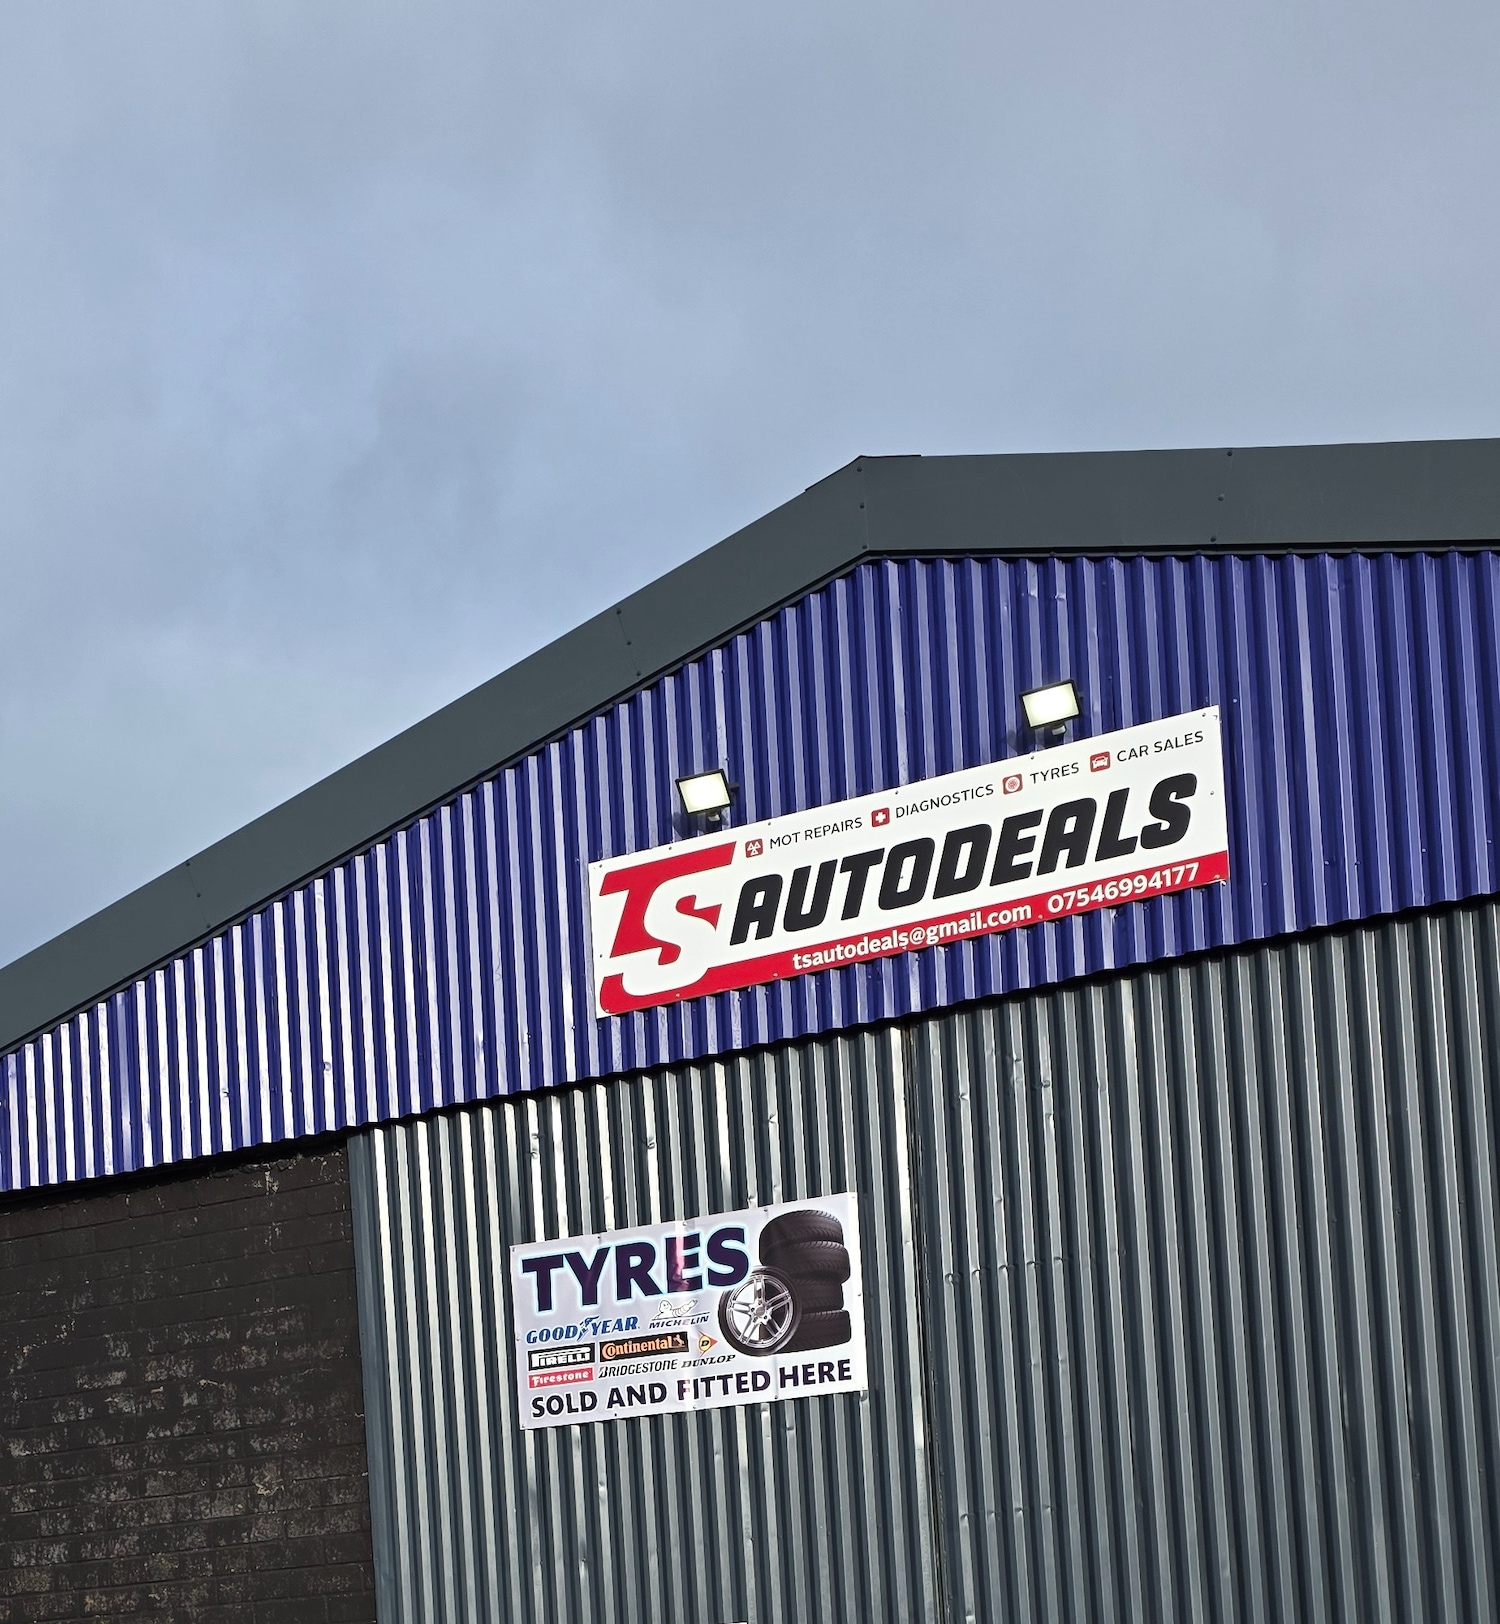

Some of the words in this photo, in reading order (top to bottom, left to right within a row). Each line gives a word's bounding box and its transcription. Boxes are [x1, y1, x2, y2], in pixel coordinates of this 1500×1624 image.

[1116, 744, 1151, 763] CAR
[1153, 731, 1204, 753] SALES
[1030, 762, 1080, 785] TYRES
[895, 783, 995, 819] DIAGNOSTICS
[769, 832, 801, 849] MOT
[804, 816, 863, 843] REPAIRS
[729, 773, 1198, 946] AUTODEALS
[792, 906, 1033, 971] tsautodeals@gmail.com
[1047, 862, 1200, 914] 07546994177
[522, 1227, 750, 1312] TYRES
[649, 1315, 710, 1329] MICHELIN
[531, 1346, 591, 1368] PIRELLI
[602, 1337, 673, 1360] Continental
[681, 1354, 736, 1369] DUNLOP
[532, 1371, 589, 1388] Firestone
[598, 1359, 678, 1379] BRIDGESTONE
[531, 1390, 598, 1419] SOLD
[607, 1383, 667, 1410] AND
[677, 1370, 770, 1402] FITTED
[779, 1358, 852, 1390] HERE
